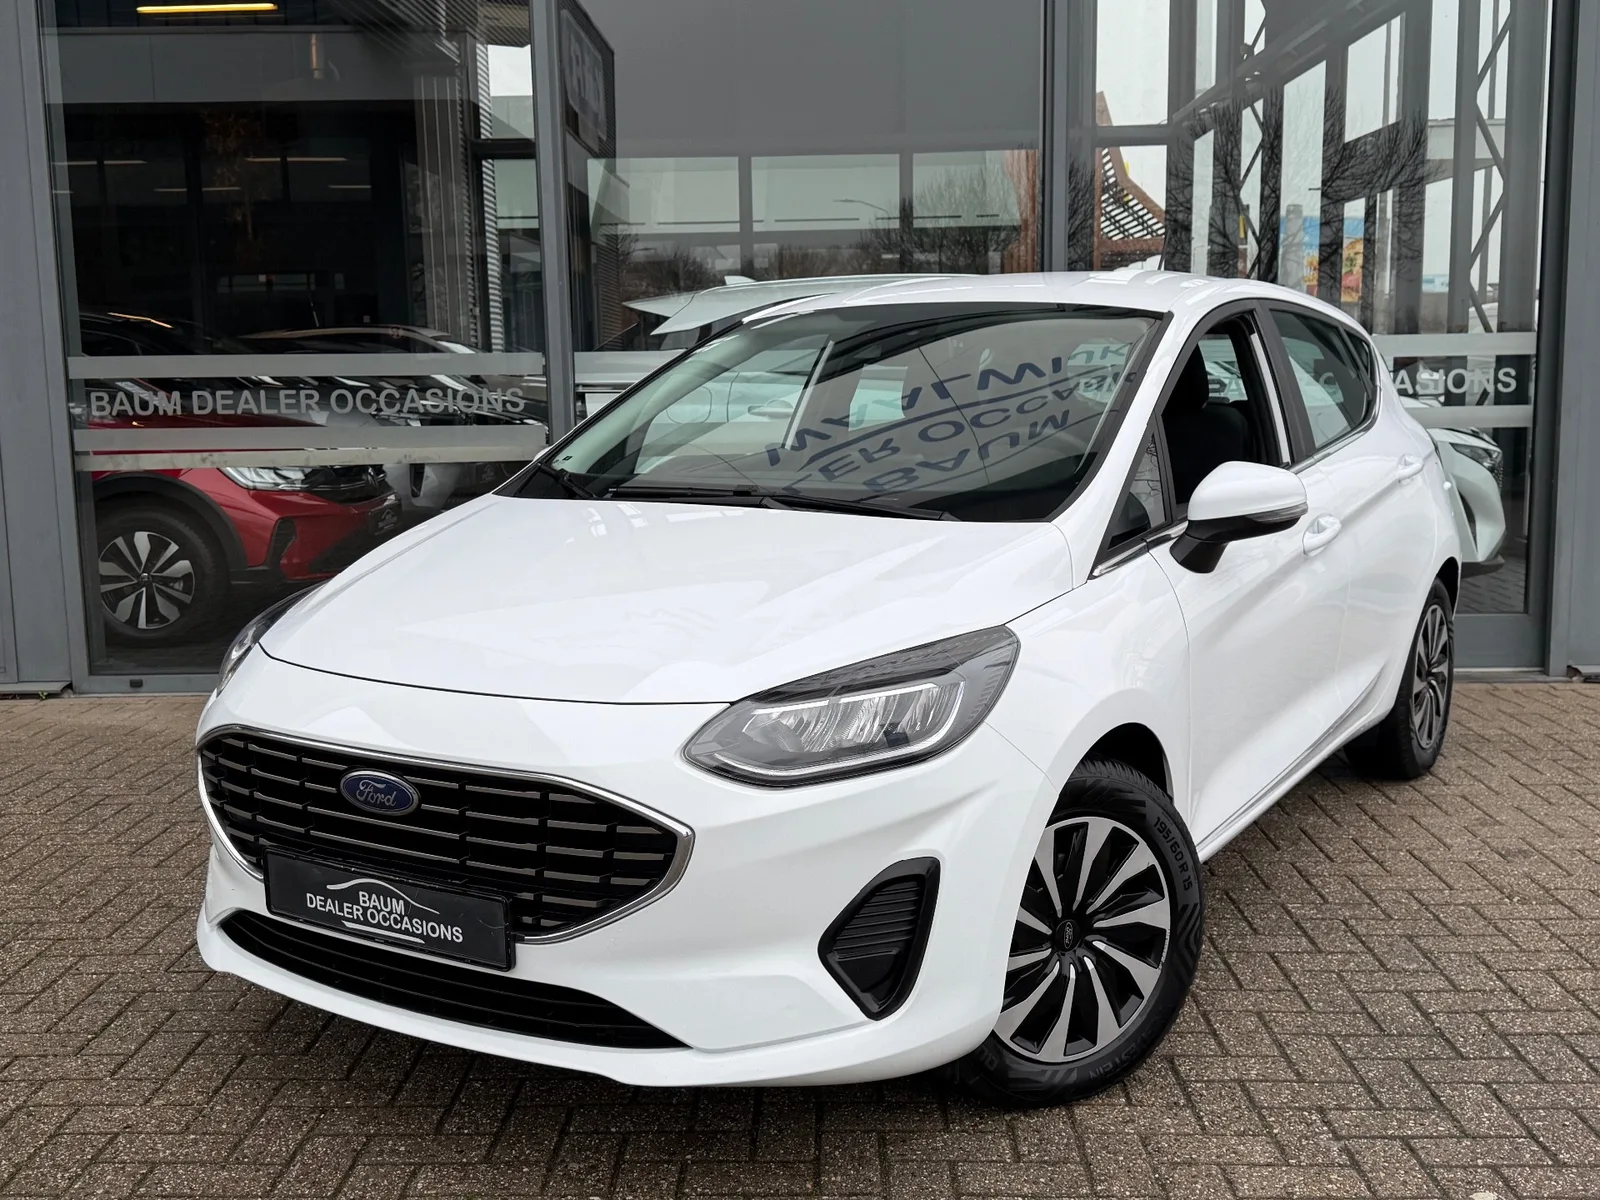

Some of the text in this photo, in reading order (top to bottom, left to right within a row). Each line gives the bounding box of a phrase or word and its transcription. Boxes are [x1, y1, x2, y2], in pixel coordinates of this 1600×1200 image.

[1393, 367, 1518, 395] ASIONS
[91, 387, 526, 417] BAUM DEALER OCCASIONS
[356, 779, 396, 807] Ford
[1154, 816, 1193, 891] 195/60 R 15
[306, 893, 463, 943] DEALER OCCASIONS
[358, 891, 405, 916] BAUM
